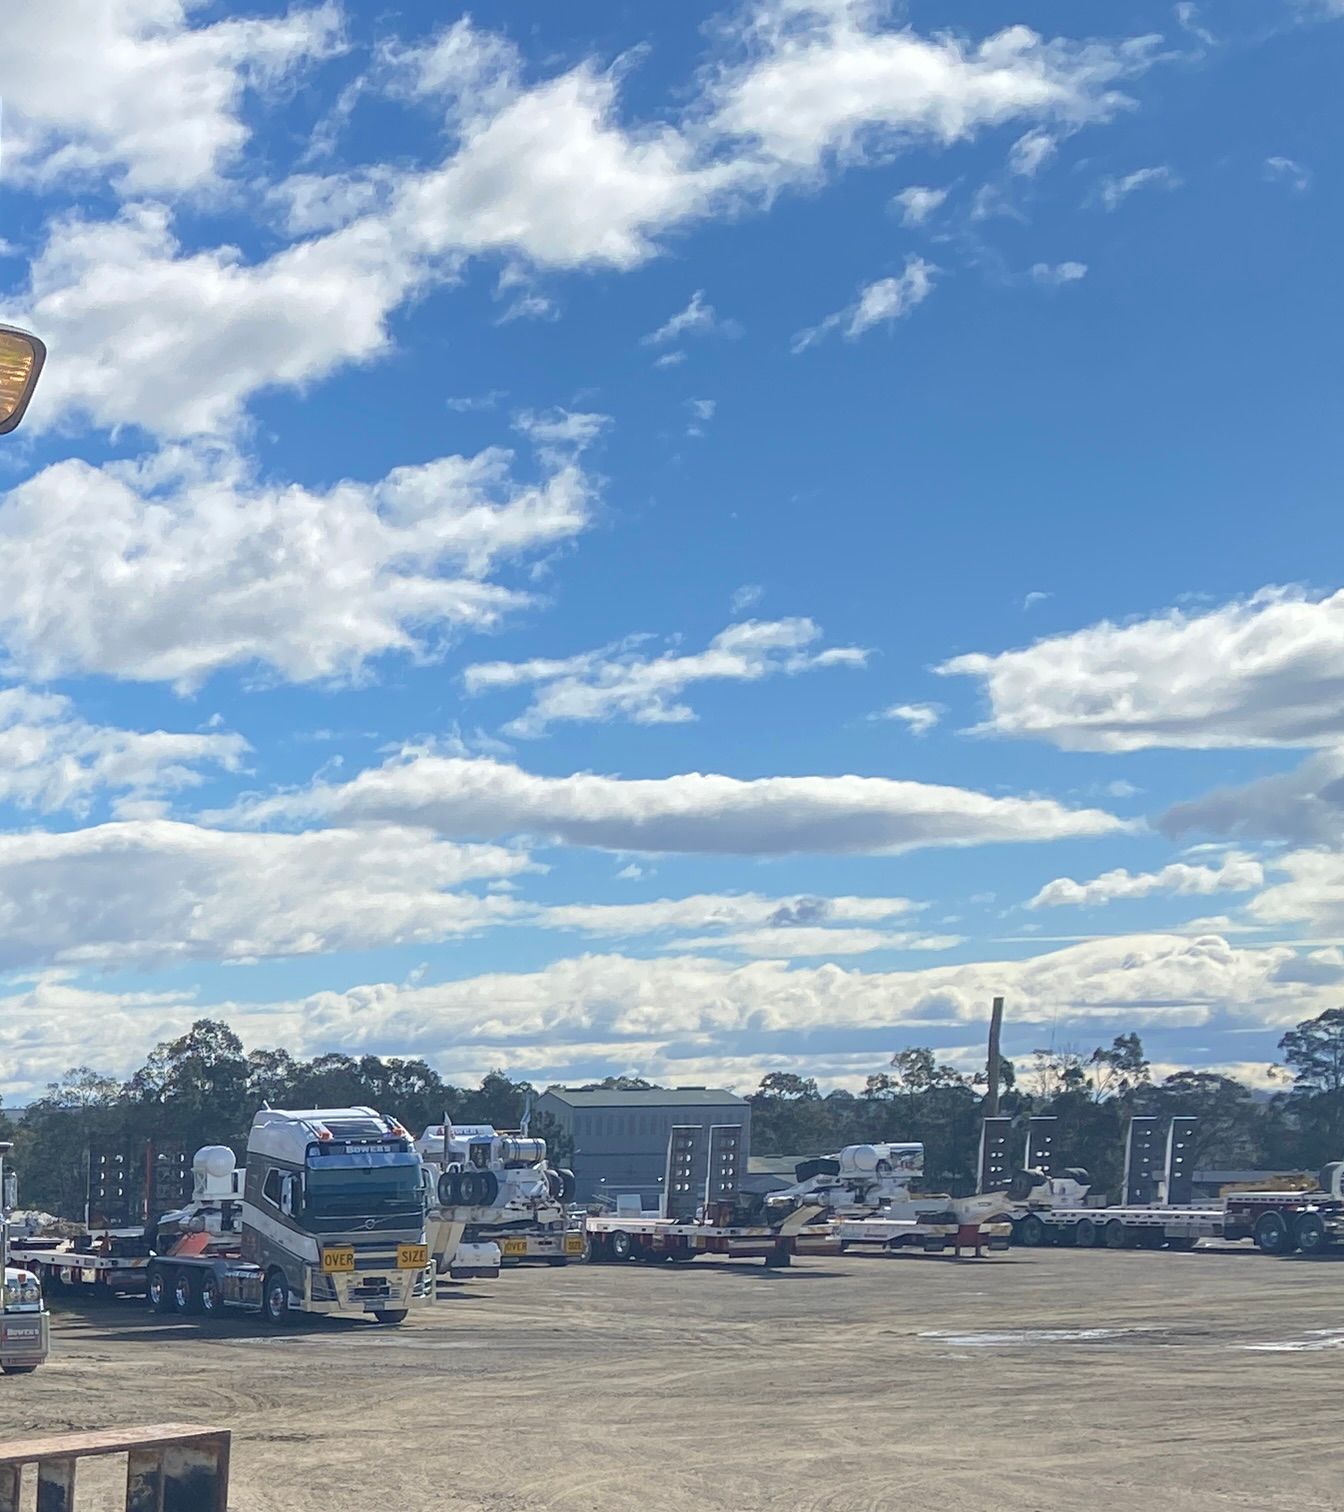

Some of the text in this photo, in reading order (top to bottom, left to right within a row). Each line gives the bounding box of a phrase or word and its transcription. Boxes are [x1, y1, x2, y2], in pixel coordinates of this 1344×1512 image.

[345, 1145, 391, 1154] BOWERS
[504, 1241, 528, 1252] OVER
[324, 1250, 426, 1267] OVER SIZE
